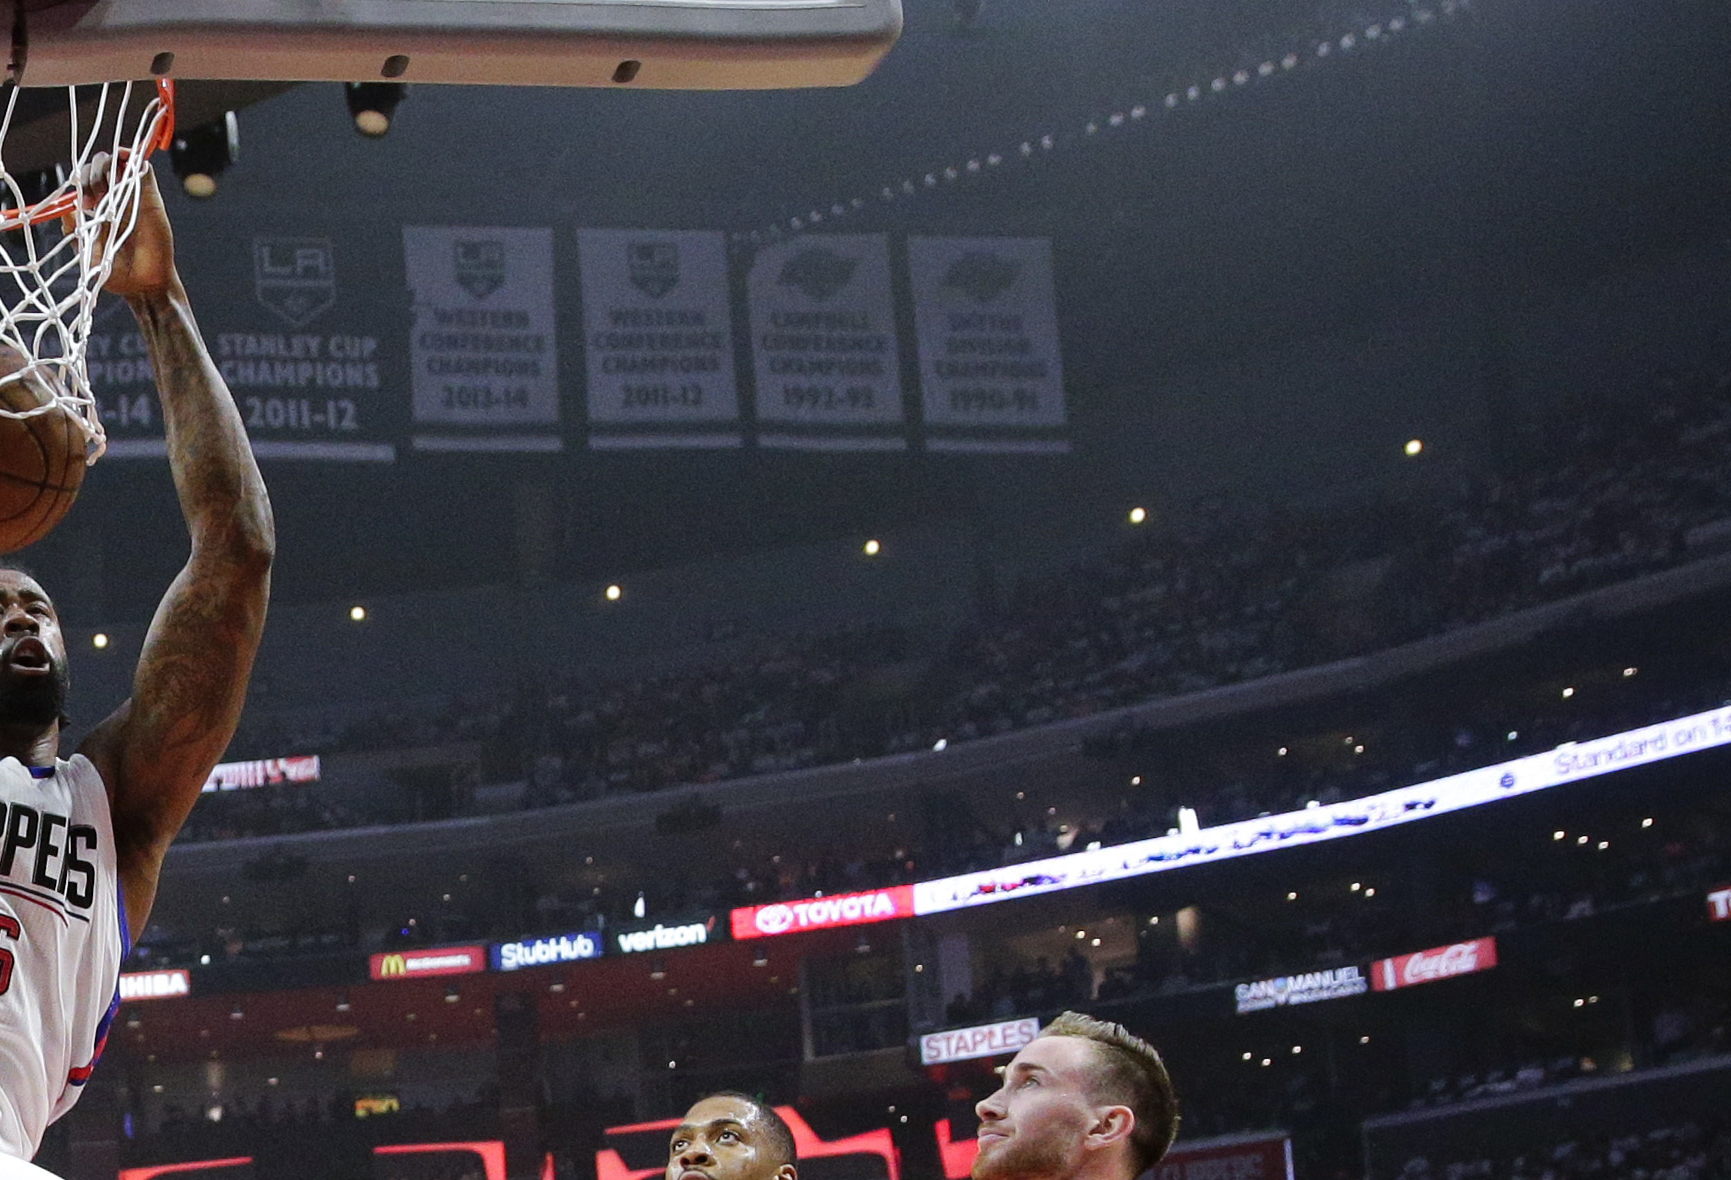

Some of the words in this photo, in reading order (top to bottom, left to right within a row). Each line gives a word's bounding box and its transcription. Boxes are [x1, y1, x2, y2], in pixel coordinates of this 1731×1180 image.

[218, 333, 318, 356] STANLEY
[328, 335, 377, 357] CUP
[221, 361, 380, 388] CHAMPIONS
[247, 399, 358, 429] 2011-12
[793, 893, 895, 927] TOYOTA
[500, 934, 595, 968] StubHub
[618, 923, 707, 952] verizon
[119, 972, 189, 999] HIBA
[1235, 981, 1276, 1002] SAN
[1286, 966, 1366, 991] MANUEL
[925, 1020, 1034, 1060] STAPLES
